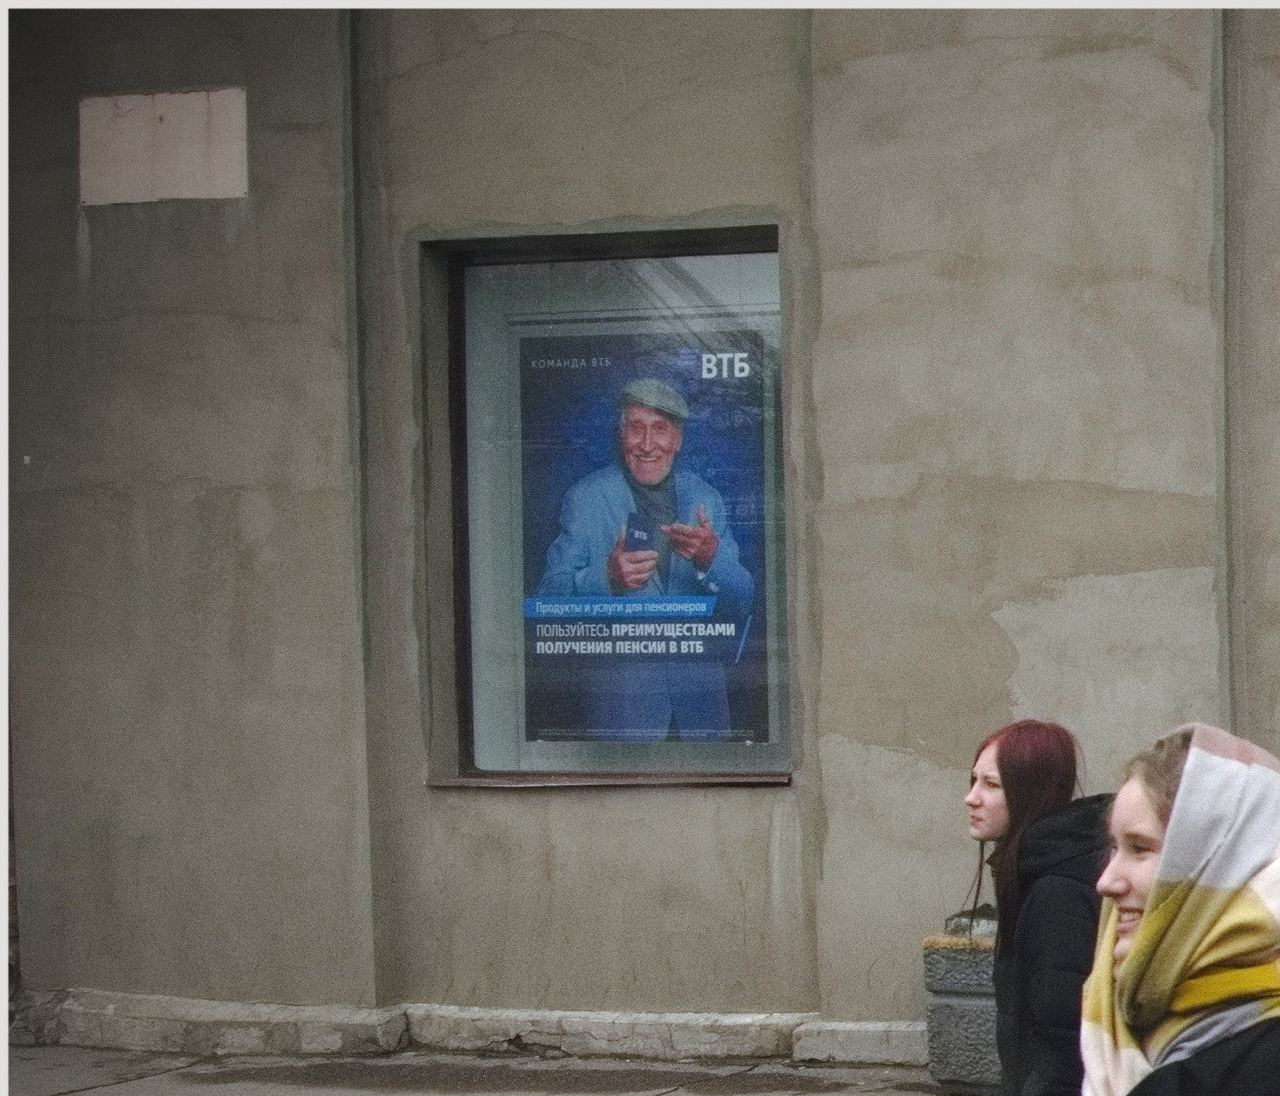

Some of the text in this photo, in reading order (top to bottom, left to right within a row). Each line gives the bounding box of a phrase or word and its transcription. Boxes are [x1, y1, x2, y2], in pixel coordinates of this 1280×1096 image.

[530, 357, 612, 369] КОМАНДА ВТБ
[701, 352, 750, 379] ВТБ
[535, 602, 707, 614] Продукты и услуги для пенсионеров
[535, 621, 736, 638] ПОЛЬЗУЙТЕСЬ ПРЕИМУЩЕСТВАМИ
[535, 640, 705, 654] ПОЛУЧЕНИЯ ПЕНСИИ В ВТБ
